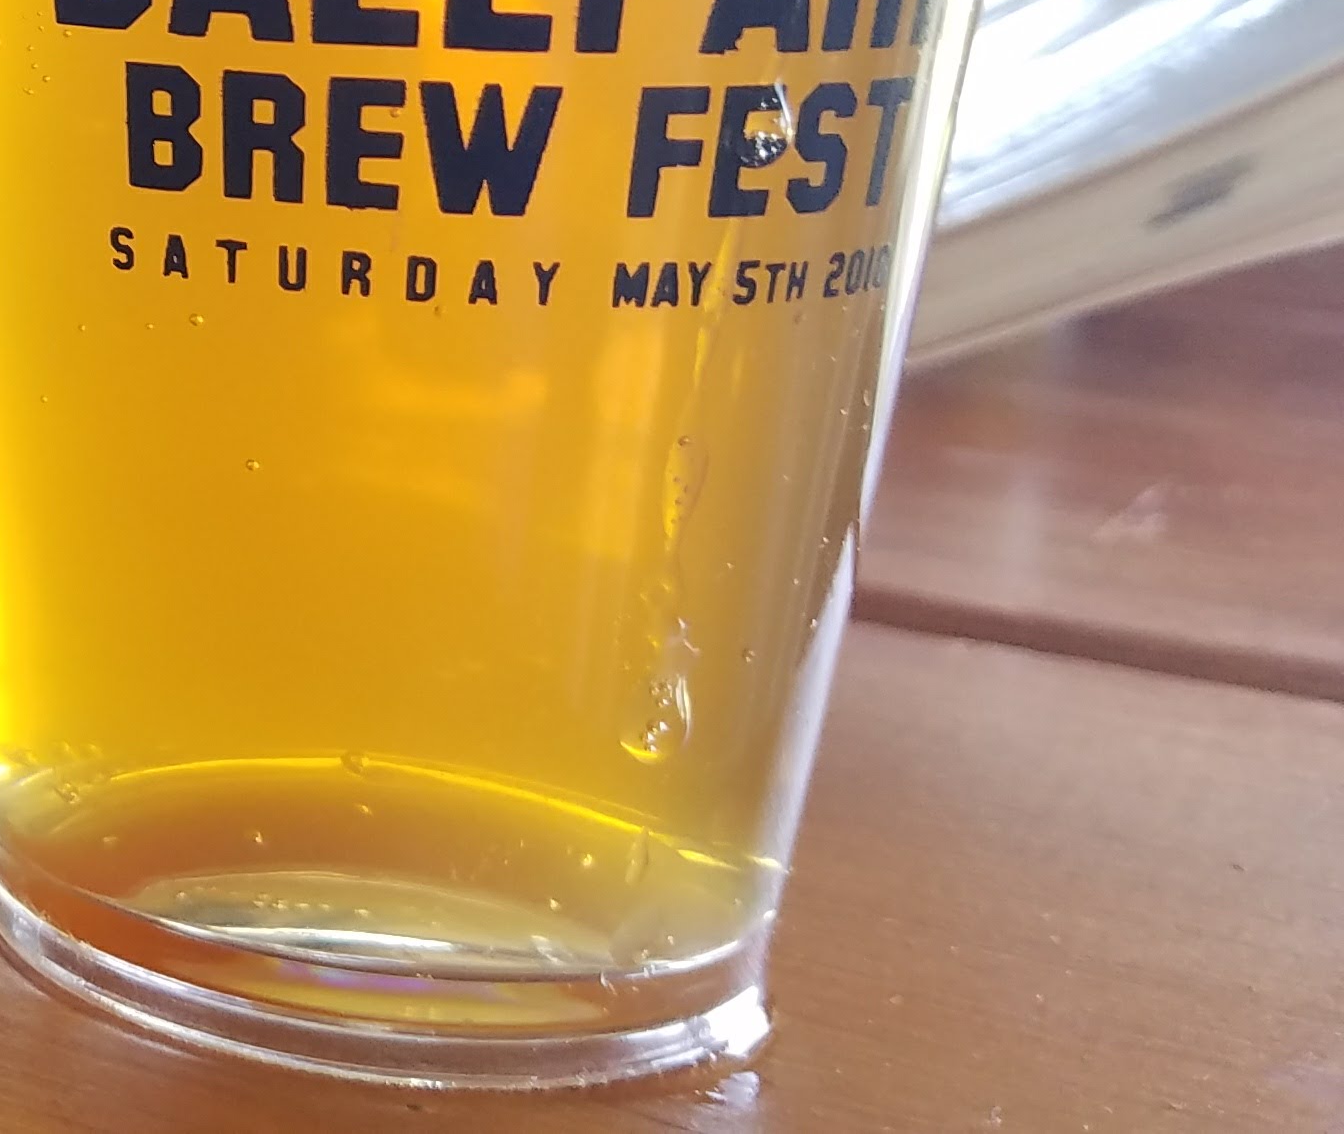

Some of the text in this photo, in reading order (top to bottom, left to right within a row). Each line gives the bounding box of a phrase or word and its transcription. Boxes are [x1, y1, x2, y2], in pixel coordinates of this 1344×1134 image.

[124, 61, 913, 219] BREW FEST
[109, 226, 560, 307] SATURDAY
[611, 260, 713, 308] MAY
[730, 259, 809, 306] 5TH
